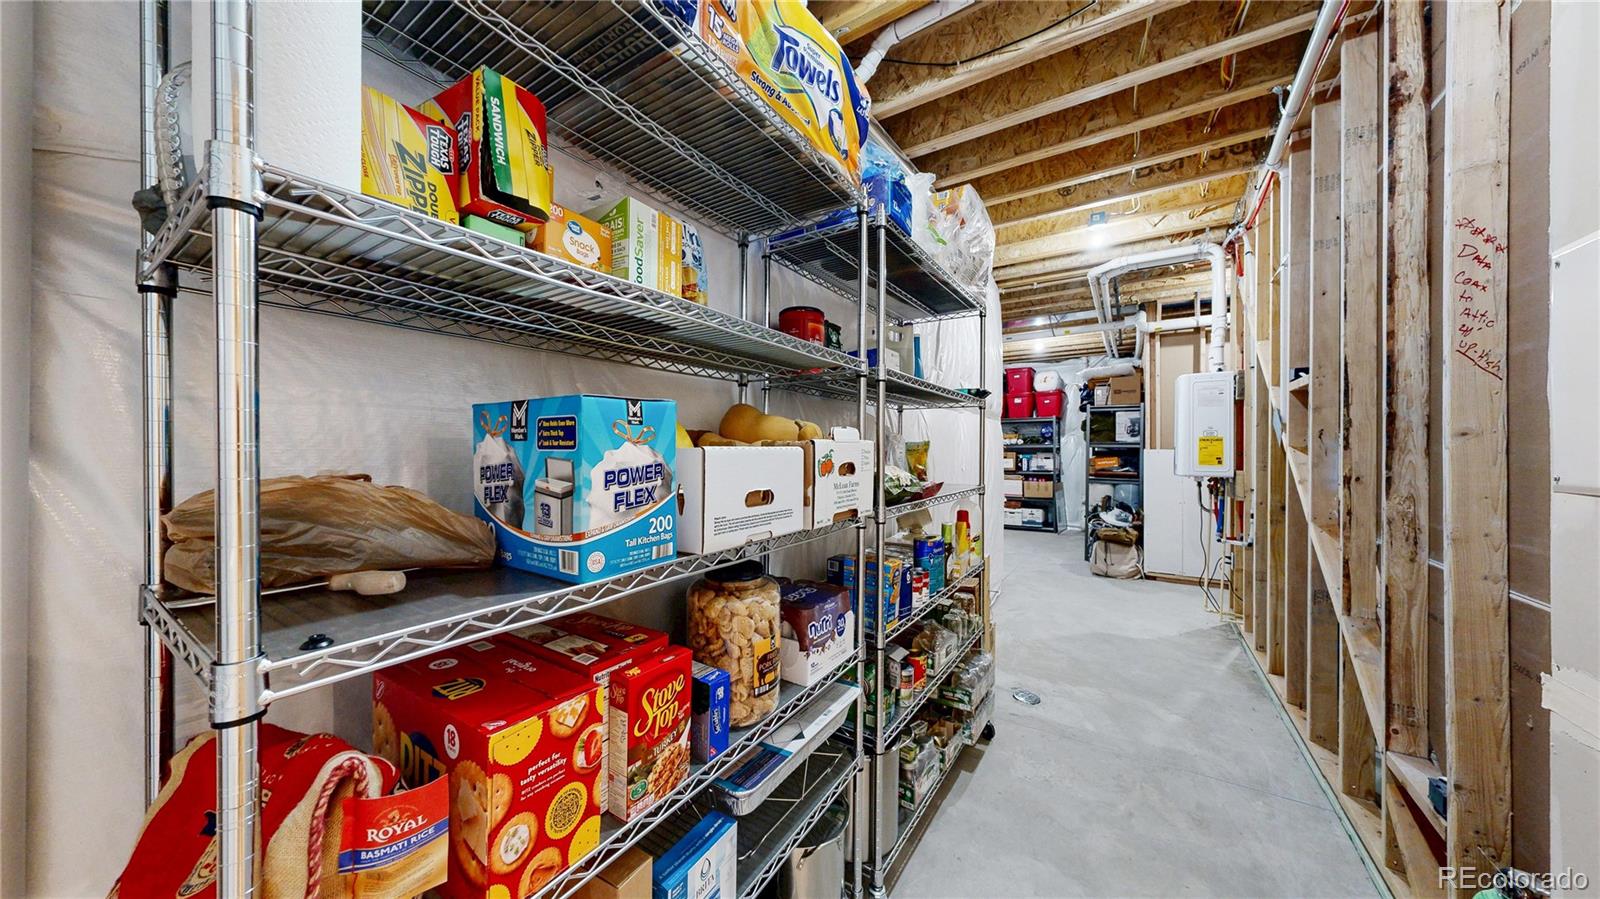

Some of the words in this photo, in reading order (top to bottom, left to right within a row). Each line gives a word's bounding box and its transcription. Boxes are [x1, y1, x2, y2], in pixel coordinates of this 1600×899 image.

[708, 4, 725, 41] 15
[770, 23, 841, 104] Towels
[750, 70, 776, 98] Strong
[490, 96, 507, 165] SANDWICH
[429, 128, 442, 167] TOUGH
[439, 133, 450, 170] TEXAS
[569, 236, 596, 256] Snack
[1459, 289, 1473, 303] to
[1459, 307, 1495, 329] Attic
[479, 462, 514, 485] POWER
[604, 462, 665, 490] POWER
[483, 485, 511, 504] FLEX
[614, 484, 658, 512] FLEX
[649, 515, 673, 534] 200
[625, 538, 636, 548] Tall
[637, 534, 661, 546] Kitchen
[660, 531, 674, 541] Bags
[432, 678, 483, 701] RITZ
[634, 673, 685, 737] Stove
[650, 700, 679, 739] Top
[446, 727, 456, 748] 18
[653, 728, 678, 757] TURKEY
[528, 757, 551, 775] perfect
[552, 752, 561, 761] for
[520, 773, 537, 786] tasty
[366, 814, 428, 843] ROYAL
[360, 840, 408, 860] BASMATI
[411, 826, 436, 844] RICE
